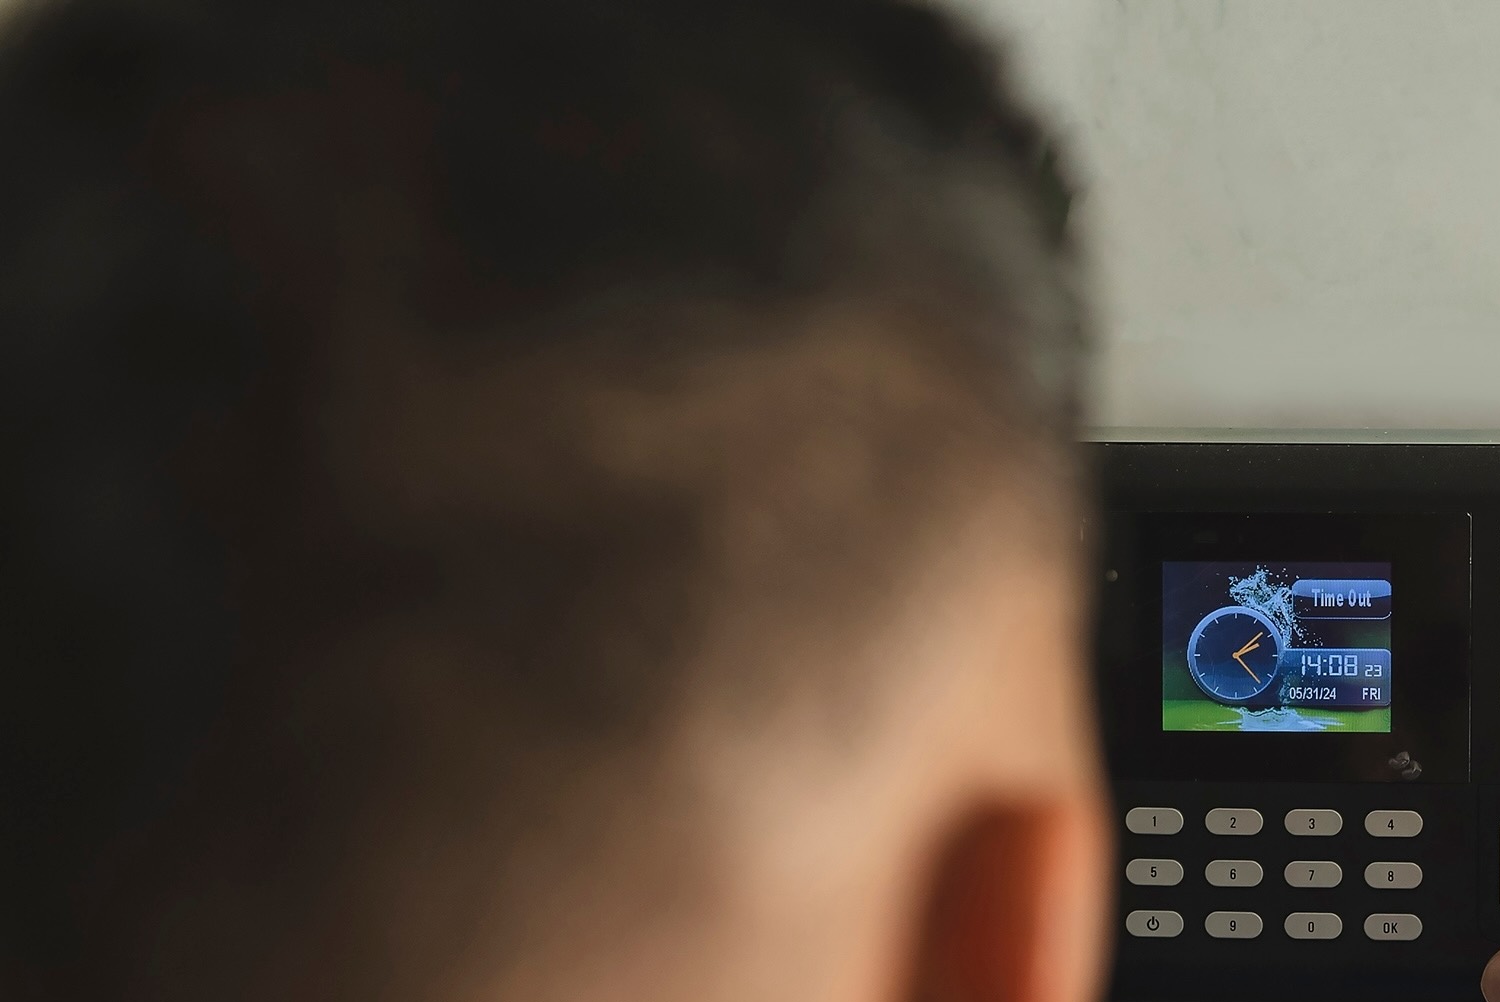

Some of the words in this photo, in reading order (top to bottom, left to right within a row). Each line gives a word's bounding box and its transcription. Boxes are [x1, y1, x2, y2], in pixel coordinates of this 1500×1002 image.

[1312, 589, 1344, 607] Time
[1348, 590, 1371, 607] Out
[1301, 654, 1357, 676] 14:08
[1364, 665, 1382, 677] 23
[1289, 687, 1336, 700] 05/31/24
[1362, 688, 1381, 700] FRI
[1229, 816, 1237, 829] 2
[1308, 817, 1316, 830] 3
[1387, 818, 1395, 831] 4
[1150, 866, 1157, 878] 5
[1229, 868, 1237, 880] 6
[1308, 869, 1315, 881] 7
[1387, 870, 1395, 882] 8
[1229, 920, 1237, 932] 9
[1307, 921, 1315, 933] 0
[1383, 922, 1398, 934] OK
